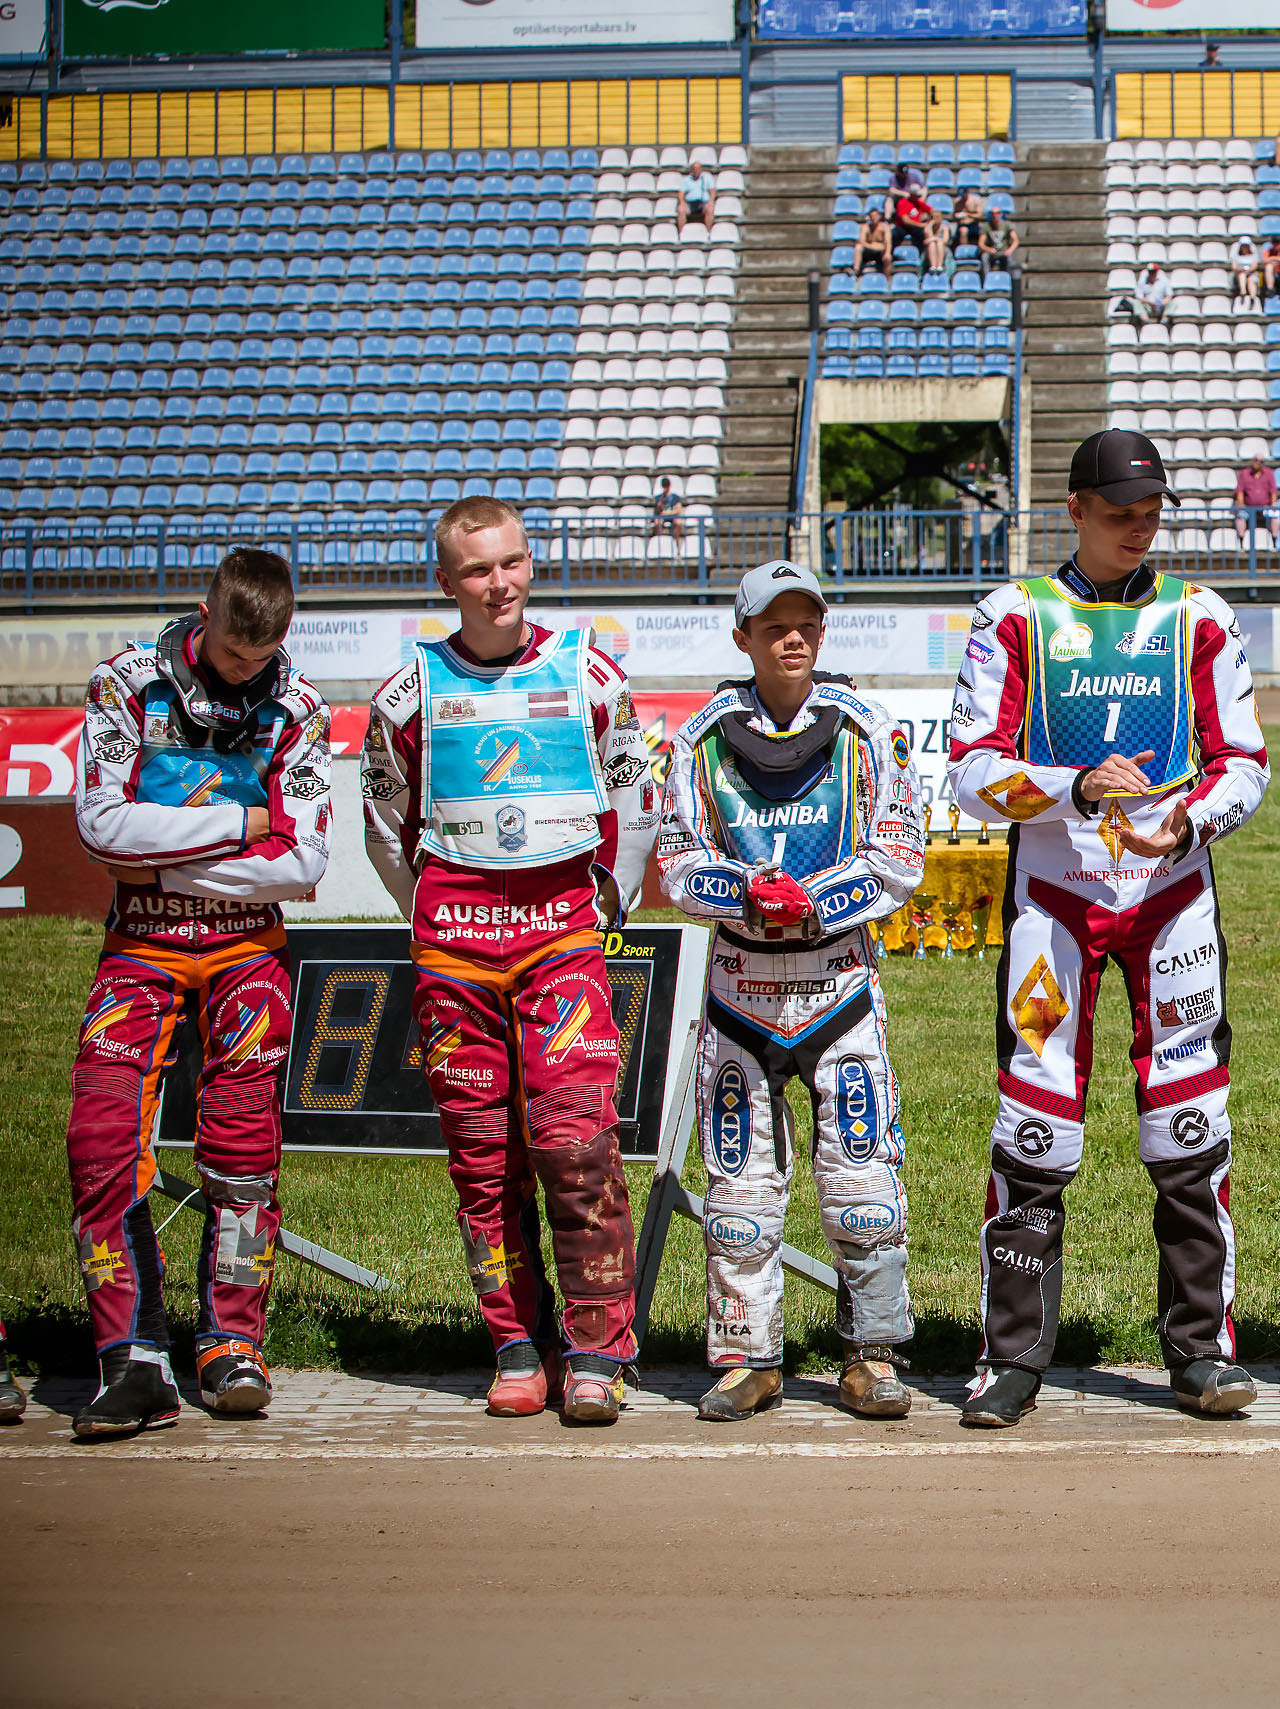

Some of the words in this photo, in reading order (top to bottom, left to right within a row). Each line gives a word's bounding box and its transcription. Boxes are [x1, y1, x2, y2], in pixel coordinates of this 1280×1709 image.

[512, 21, 637, 37] optibetsportabars.lv
[930, 84, 939, 105] L
[290, 620, 369, 635] DAUGAVPILS
[636, 615, 720, 631] DAUGAVPILS
[304, 639, 335, 653] MANA
[1060, 668, 1162, 698] JAUNĪBA
[820, 687, 842, 702] EAST
[840, 692, 866, 714] METAL
[687, 710, 708, 734] EAST
[706, 698, 729, 717] METAL
[1103, 702, 1122, 742] 1
[524, 726, 542, 751] CENTRS
[492, 770, 542, 792] AUSEKLIS
[889, 803, 916, 820] PICA
[879, 822, 902, 832] Auto
[771, 832, 787, 864] 1
[1062, 867, 1111, 883] AMBER
[1113, 866, 1170, 881] STUDIOS
[690, 875, 729, 898] CKD
[126, 896, 265, 918] AUSEKLIS
[433, 901, 571, 925] AUSEKLIS
[757, 897, 783, 911] THOR
[216, 916, 266, 934] klubs
[520, 917, 569, 936] klubs
[237, 980, 273, 995] JAUNIEŠU
[541, 982, 551, 996] UN
[549, 972, 589, 990] JAUNIEŠU
[589, 978, 610, 1007] CENTRS
[739, 981, 776, 993] Auto
[1176, 986, 1216, 1010] YOGGY
[1185, 1001, 1216, 1022] BEAR
[88, 1028, 142, 1059] AUSEKLIS
[565, 1032, 617, 1062] AUSEKLIS
[585, 1051, 609, 1059] ANNO
[436, 1057, 495, 1081] AUSEKLIS
[722, 1069, 742, 1090] D
[445, 1079, 471, 1087] ANNO
[841, 1062, 868, 1118] CKD
[720, 1111, 741, 1170] CKD
[850, 1138, 871, 1156] D
[90, 1256, 120, 1270] muzejs
[715, 1321, 752, 1337] PICA
